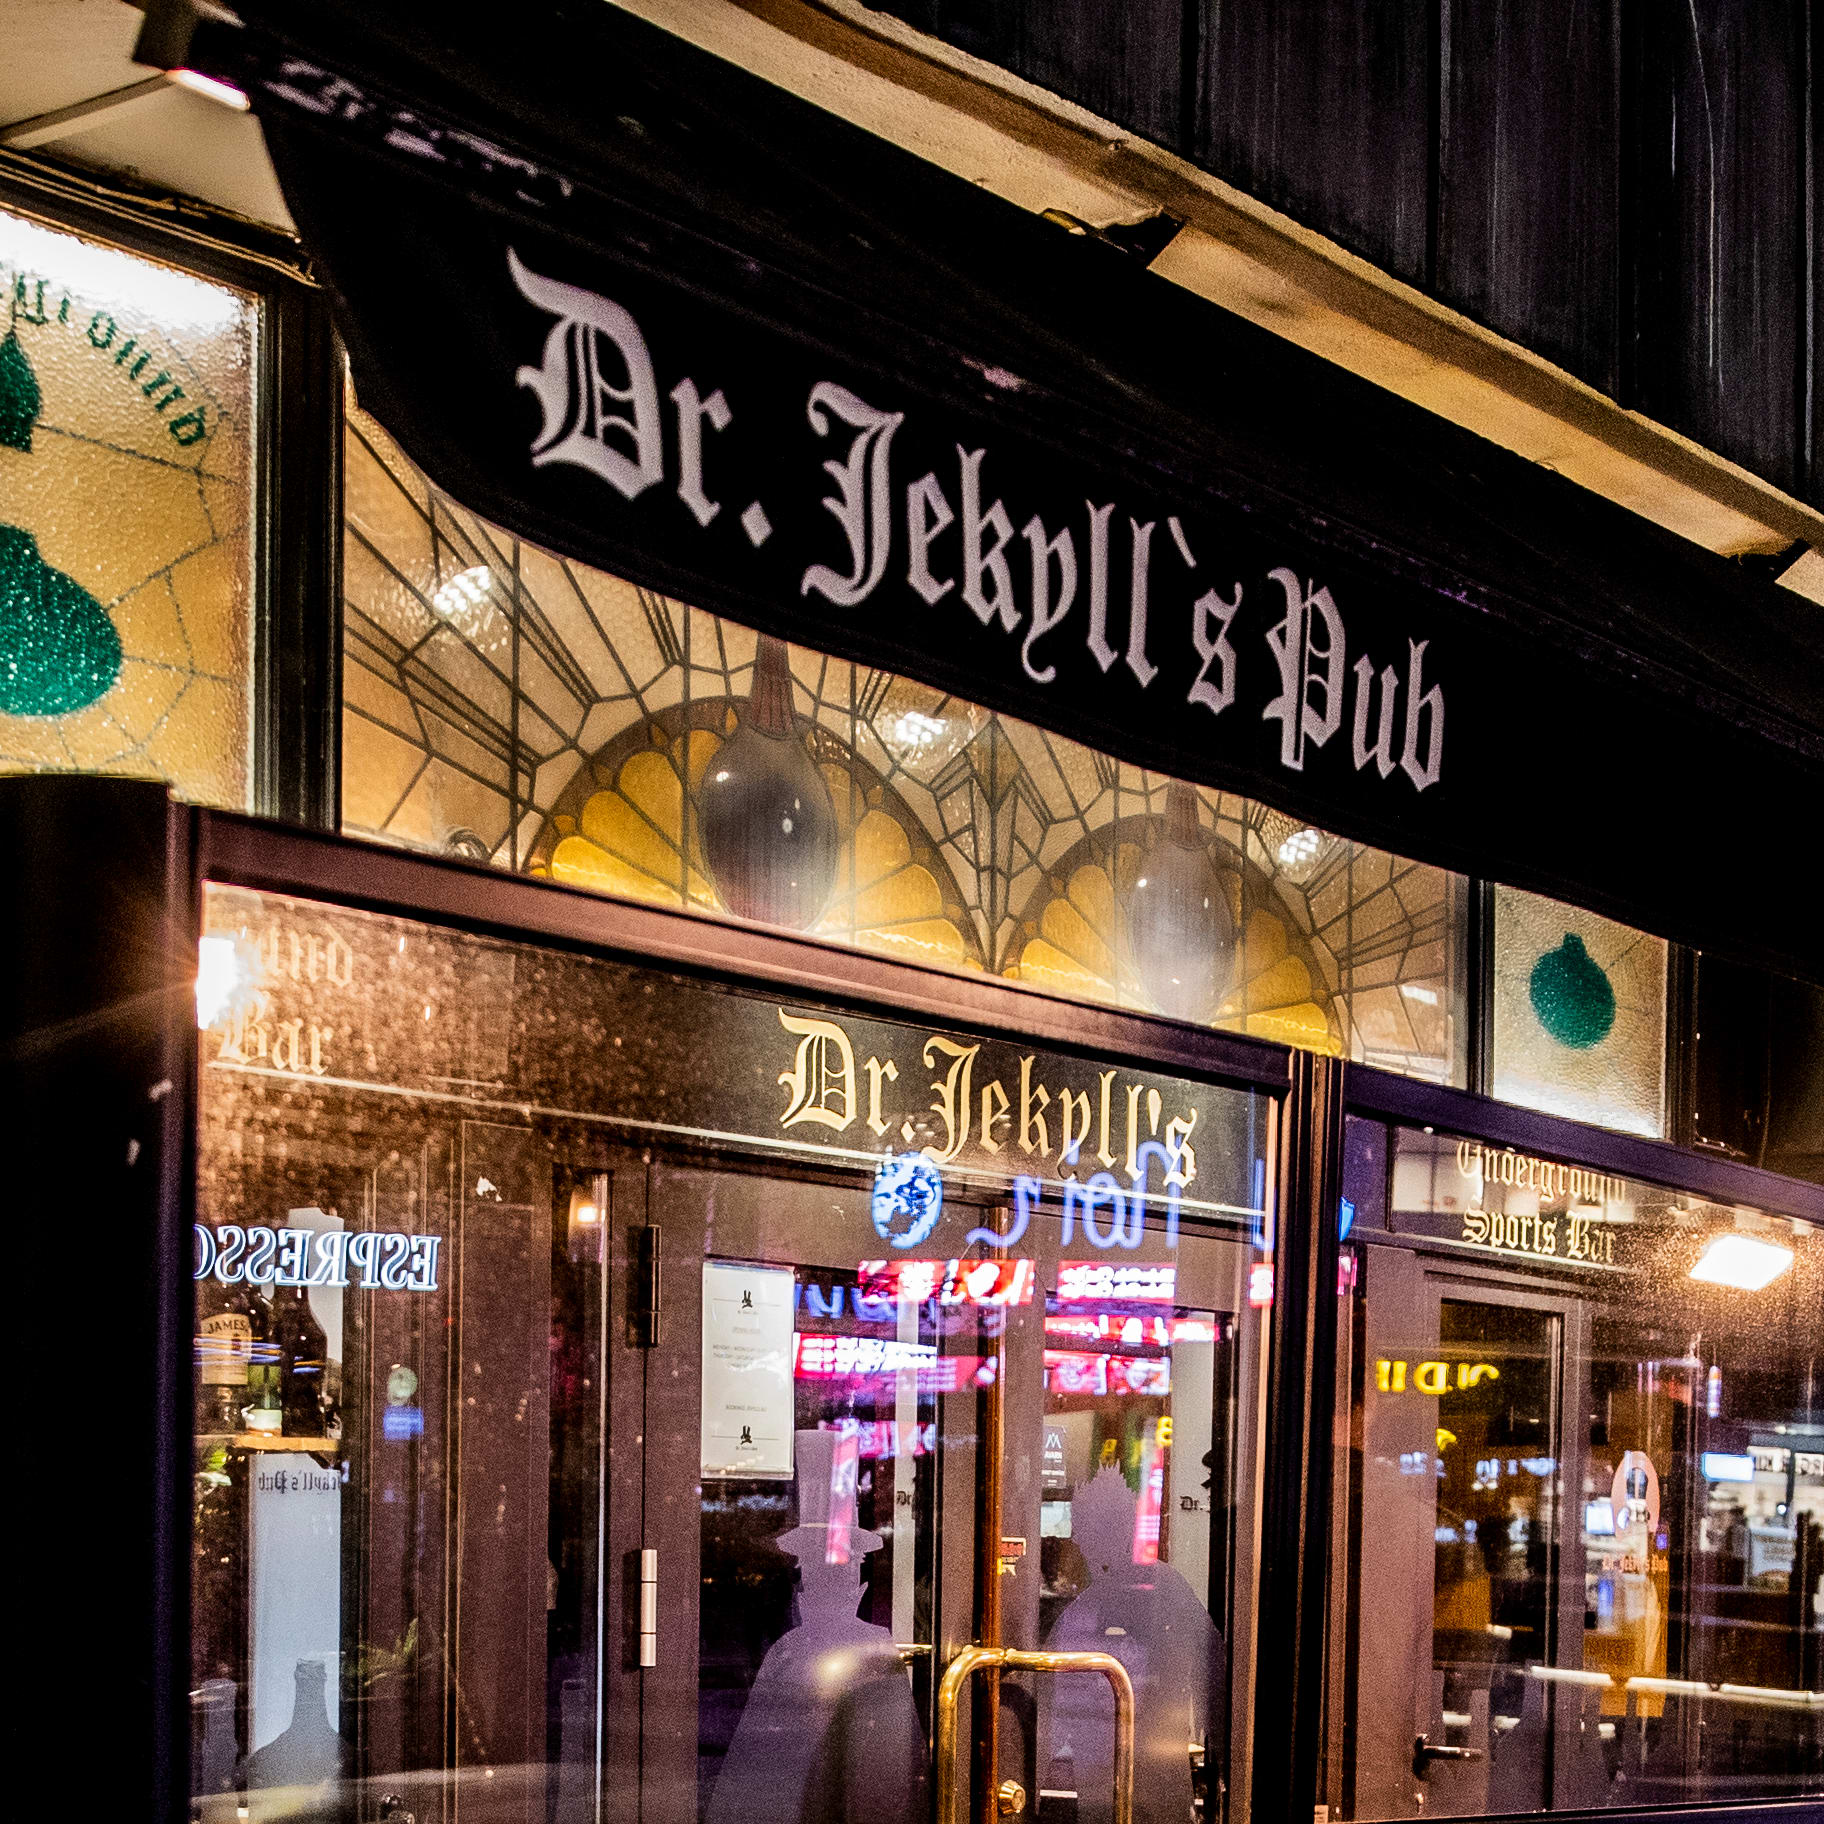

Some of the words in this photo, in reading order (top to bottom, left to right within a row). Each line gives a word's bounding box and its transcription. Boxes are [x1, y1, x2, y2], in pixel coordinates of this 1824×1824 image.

[506, 245, 773, 546] Dr.
[1261, 567, 1446, 791] Pub
[776, 1007, 916, 1142] Dr.
[1462, 1204, 1557, 1255] Sports
[1566, 1210, 1617, 1264] Bar
